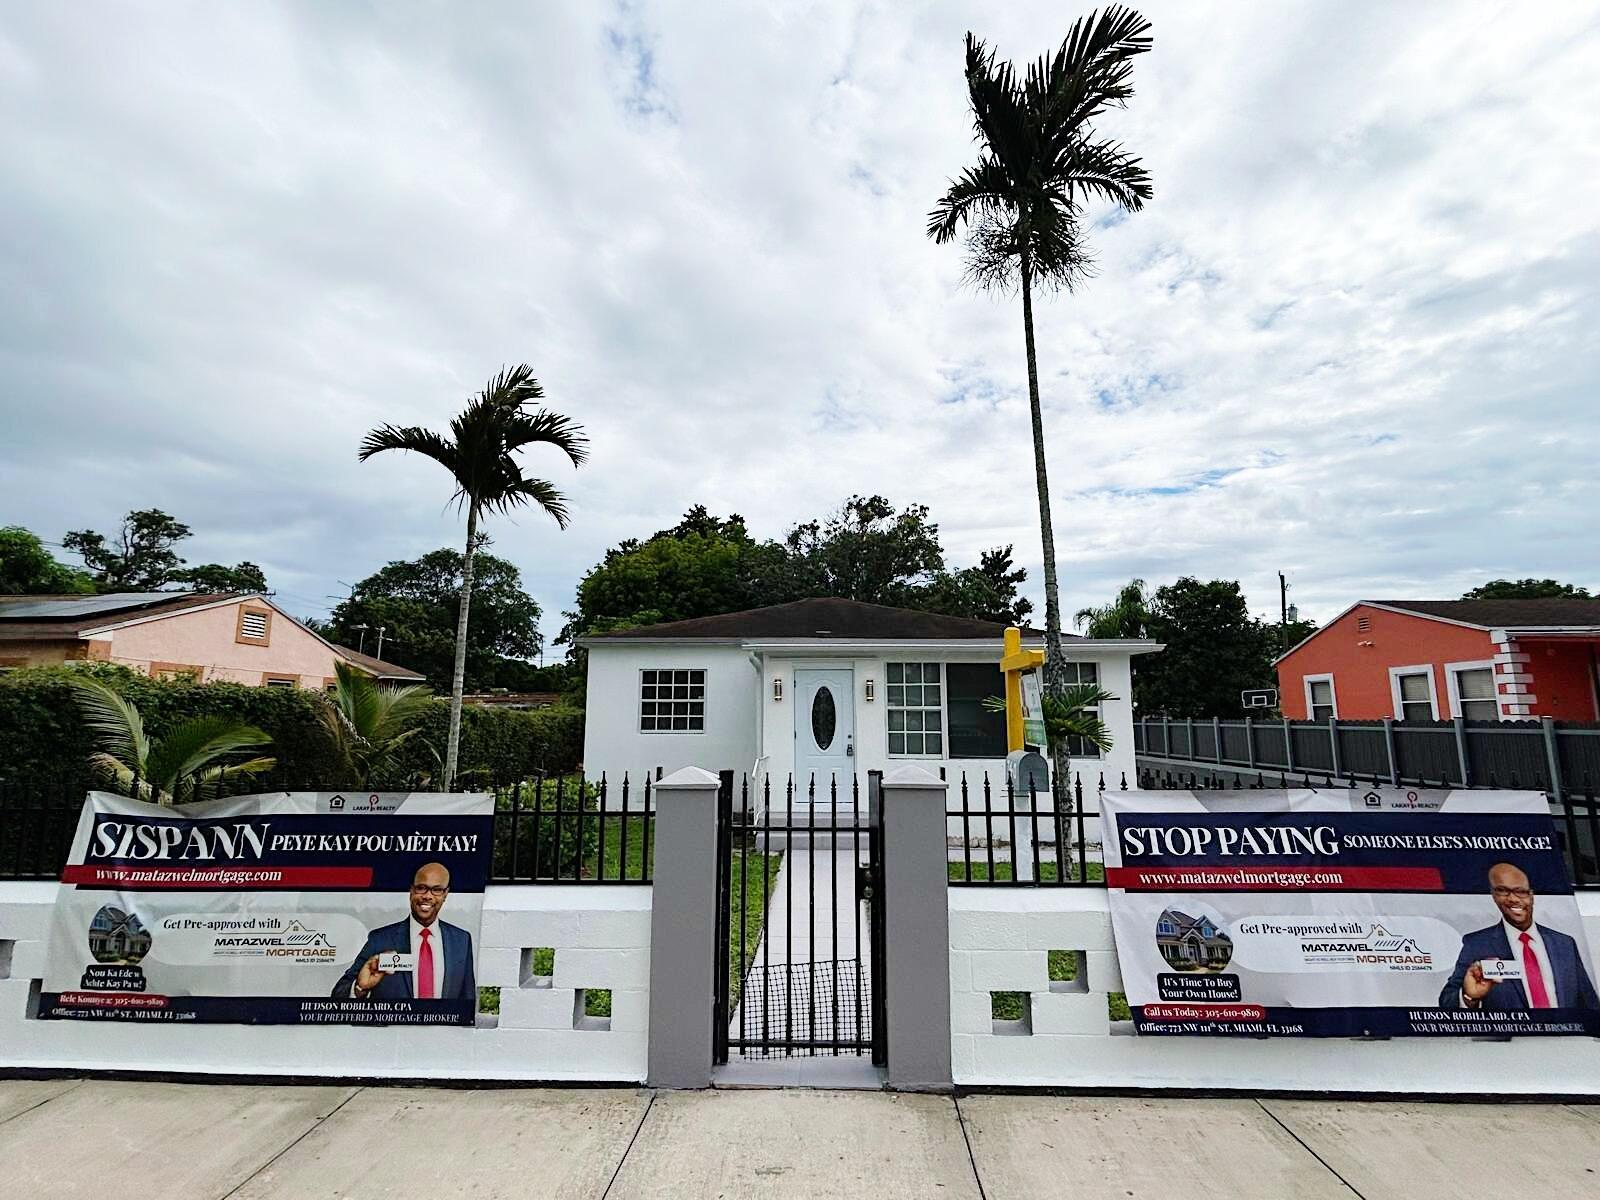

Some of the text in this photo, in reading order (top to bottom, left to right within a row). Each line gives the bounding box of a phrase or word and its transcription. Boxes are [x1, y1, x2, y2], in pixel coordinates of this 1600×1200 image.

[90, 821, 478, 860] SISPANN PEYE KAY POU MÈT KAY!
[1123, 826, 1552, 856] STOP PAYING SOMEONE ELSE'S MORTGAGE!
[96, 868, 282, 884] www.matazwelmortgage.com
[1139, 870, 1344, 887] www.matazwelmortgage.com
[163, 917, 281, 931] Get Pre-approved with
[1240, 922, 1363, 936] Get Pre-approved with
[214, 938, 285, 946] MATAZWEL
[265, 948, 337, 957] MORTGAGE
[1301, 943, 1373, 952] MATAZWEL
[1356, 955, 1432, 964] MORTGAGE
[89, 969, 106, 977] Nou
[107, 969, 118, 977] Ka
[106, 979, 121, 989] Kay
[1163, 977, 1234, 989] It's Time To Buy
[1161, 988, 1239, 999] Your Own House!
[300, 1002, 338, 1011] HUDSON
[394, 1002, 412, 1011] CPA
[90, 1009, 105, 1017] NW
[299, 1013, 460, 1022] YOUR PREFFERED MORTGAGE BROKER!
[1143, 1007, 1260, 1018] Call us Today: 305-610-9819
[1409, 1011, 1451, 1021] HUDSON
[1511, 1011, 1531, 1021] CPA
[1140, 1022, 1167, 1032] Office:
[1168, 1025, 1182, 1033] 773
[1182, 1023, 1199, 1032] NW
[1280, 1024, 1304, 1034] 33168
[1411, 1023, 1438, 1033] YOUR
[1439, 1023, 1492, 1033] PREFFERED
[1492, 1023, 1544, 1032] MORTGAGE
